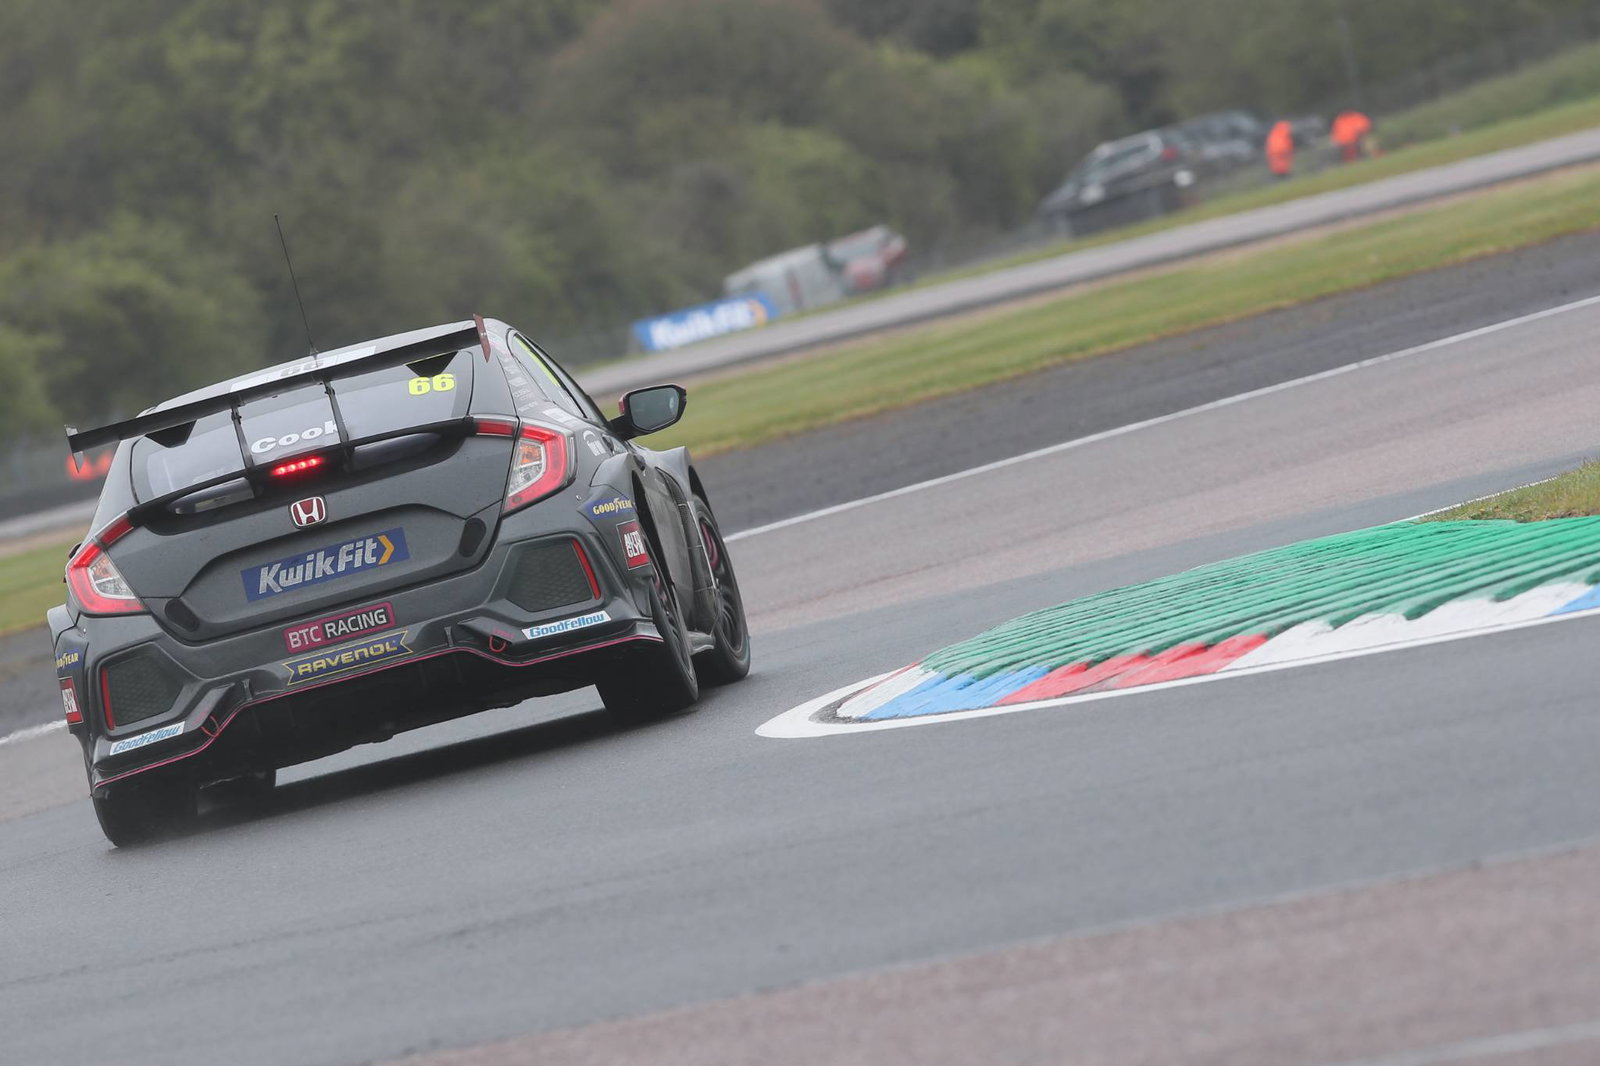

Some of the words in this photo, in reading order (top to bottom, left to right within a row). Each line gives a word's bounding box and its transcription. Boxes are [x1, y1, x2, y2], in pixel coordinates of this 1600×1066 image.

[408, 373, 455, 396] 66
[288, 625, 321, 649] BTC
[324, 608, 387, 638] RACING
[297, 641, 398, 676] RAVENOL
